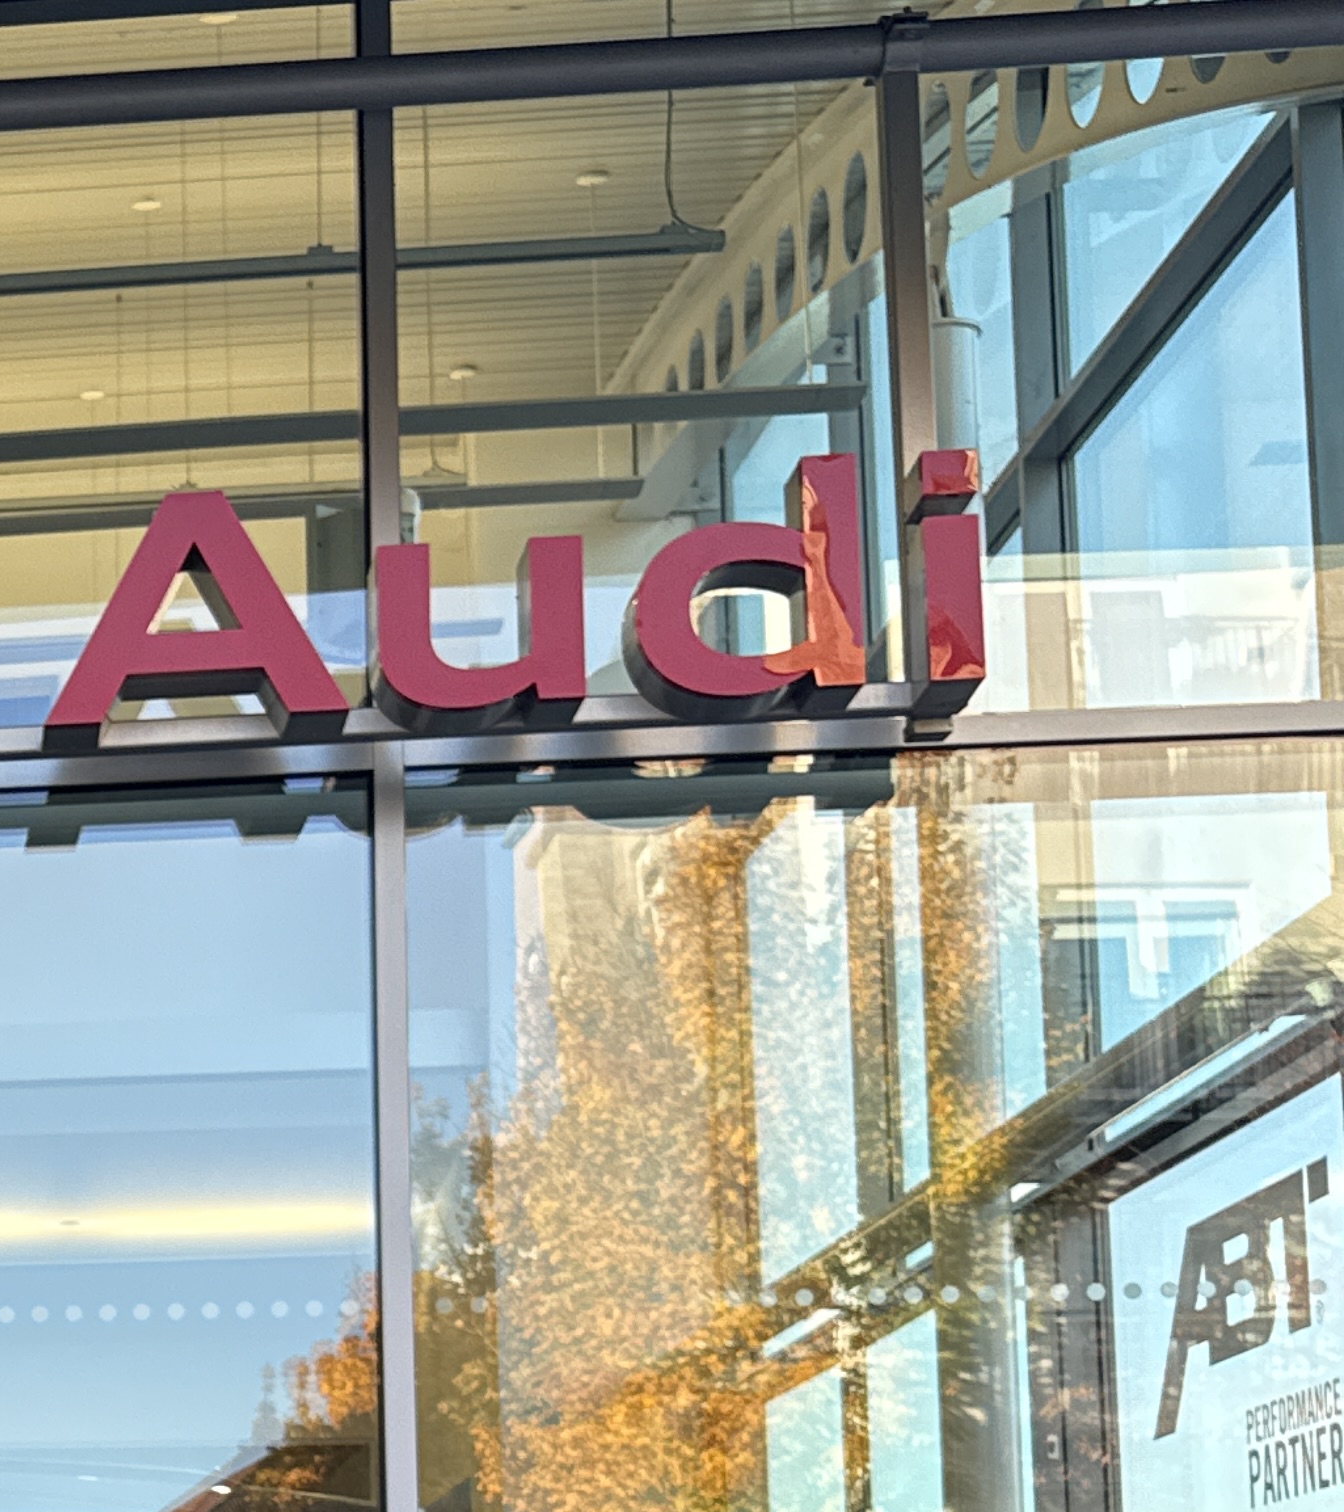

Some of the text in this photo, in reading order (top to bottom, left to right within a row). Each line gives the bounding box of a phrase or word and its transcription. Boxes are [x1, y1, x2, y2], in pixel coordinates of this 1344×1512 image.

[44, 449, 986, 740] Audi
[1153, 1155, 1330, 1441] ABT
[1245, 1377, 1343, 1445] PERFORMANCE
[1248, 1422, 1344, 1509] PARTNER
